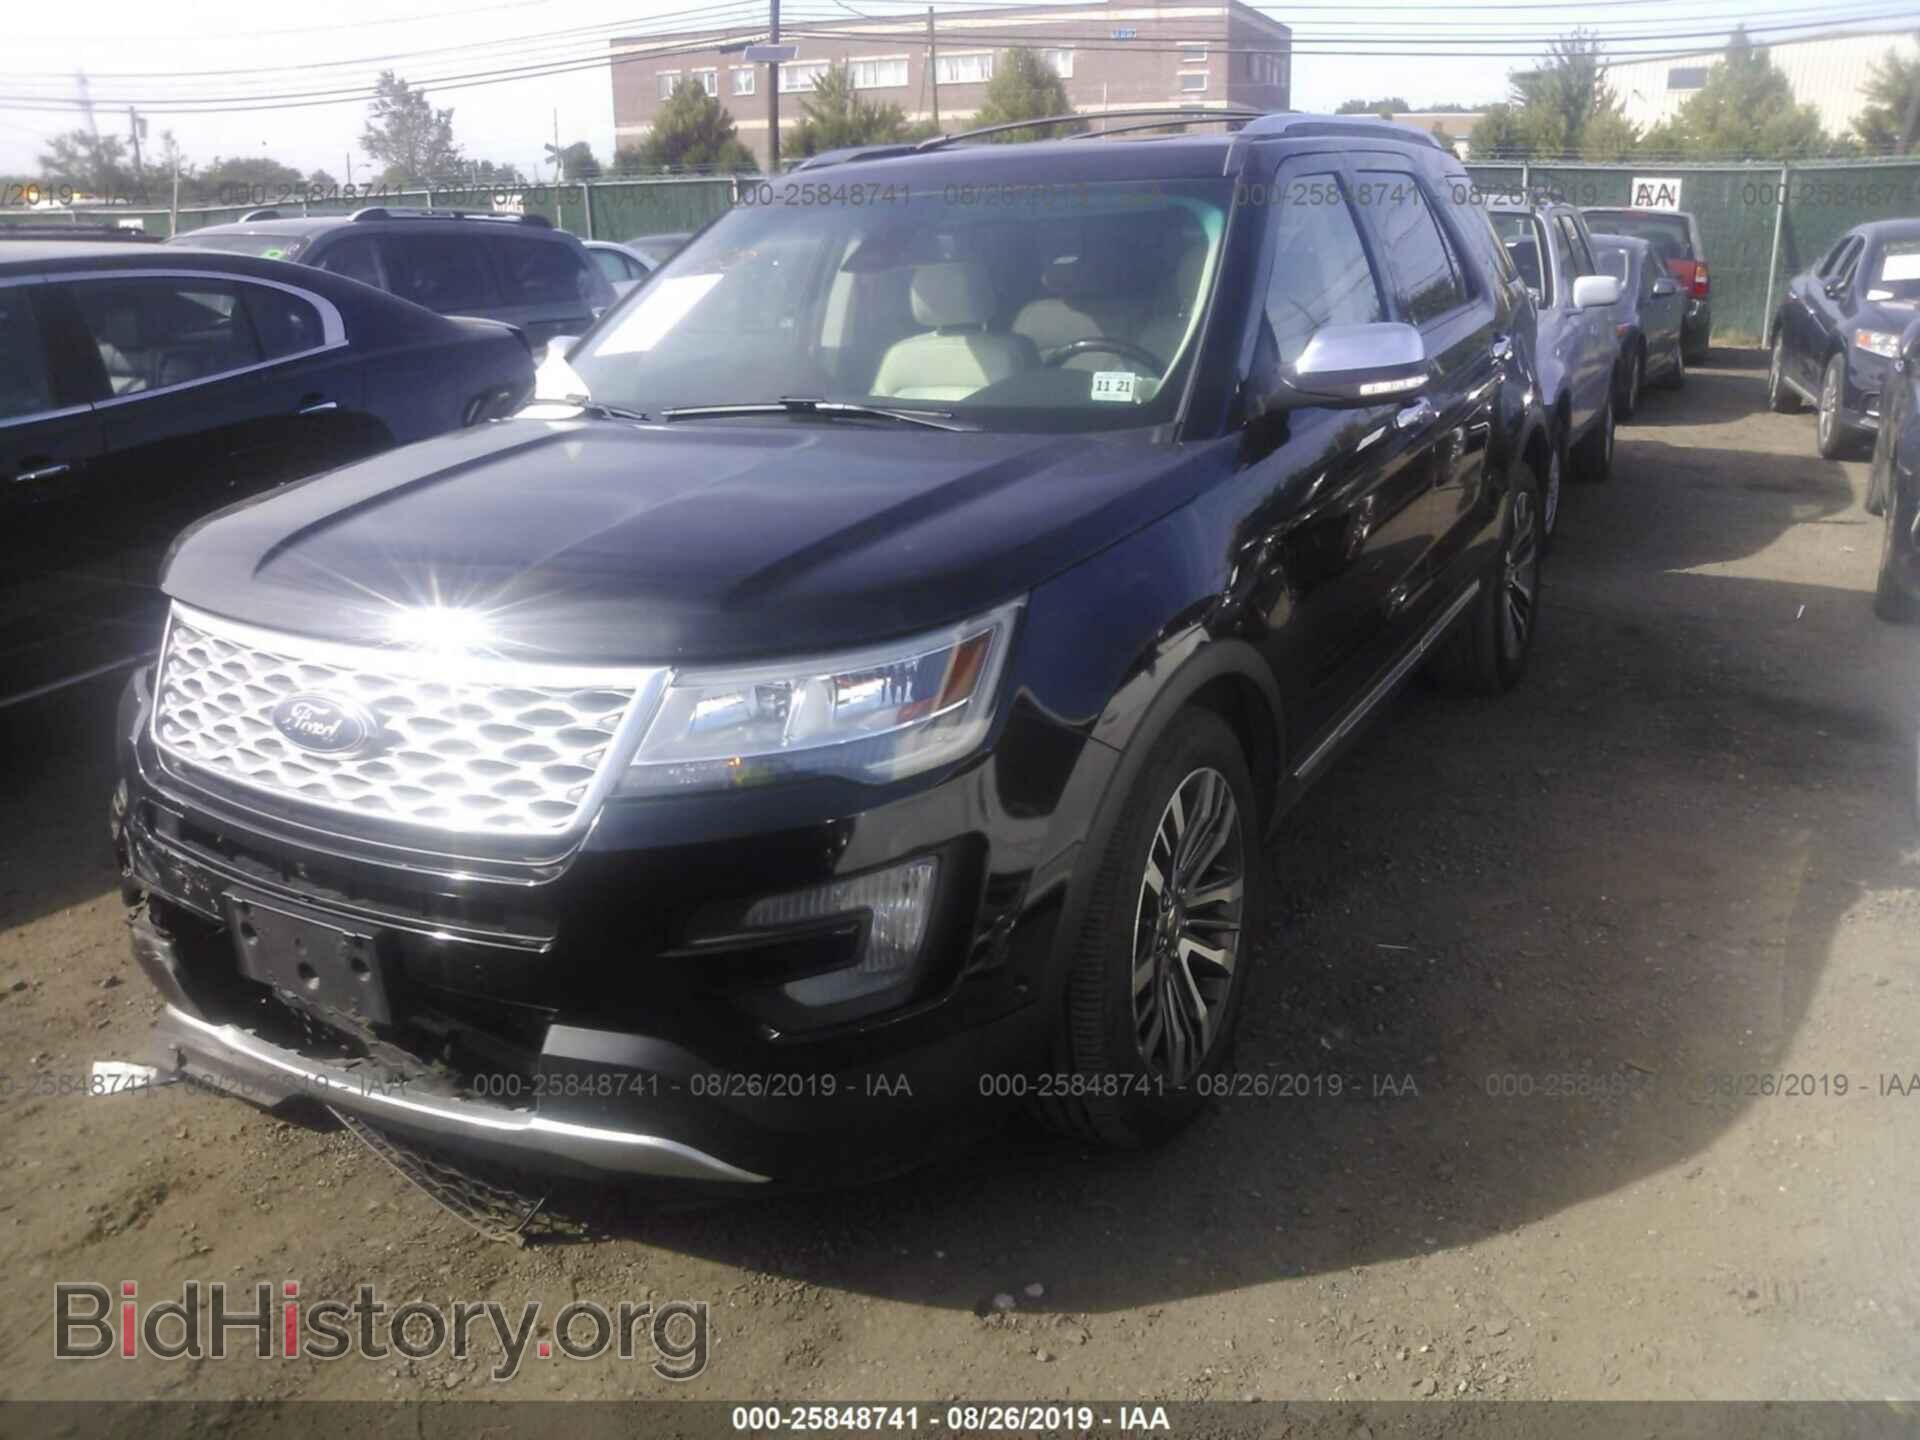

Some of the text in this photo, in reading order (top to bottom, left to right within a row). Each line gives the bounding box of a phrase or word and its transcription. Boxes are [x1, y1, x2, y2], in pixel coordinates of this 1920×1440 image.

[1095, 380, 1131, 392] 11 21
[281, 701, 344, 742] Ford
